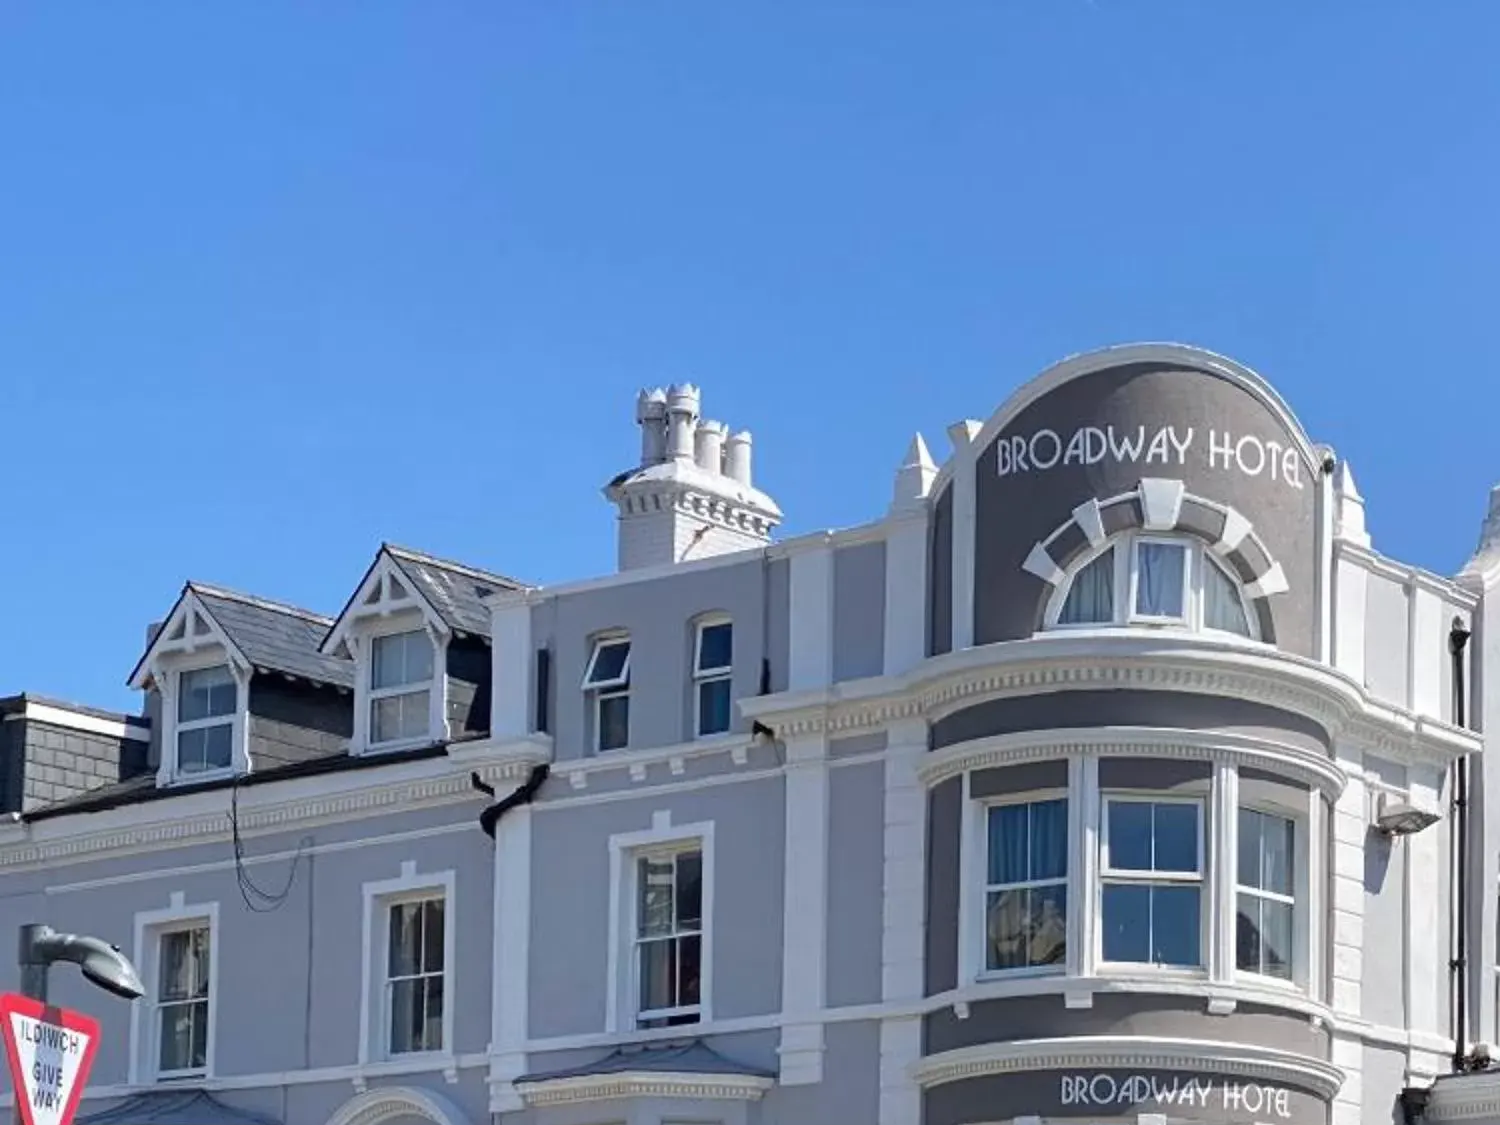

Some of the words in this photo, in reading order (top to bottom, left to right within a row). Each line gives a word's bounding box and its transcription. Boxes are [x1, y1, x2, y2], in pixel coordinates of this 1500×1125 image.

[998, 425, 1193, 476] BROADWAY
[1209, 429, 1304, 490] HOTEL
[21, 1018, 80, 1054] ILDIWCH
[32, 1060, 63, 1087] GIVE
[32, 1087, 63, 1113] WAY
[1060, 1073, 1212, 1107] BROADWAY
[1223, 1080, 1292, 1118] HOTEL
